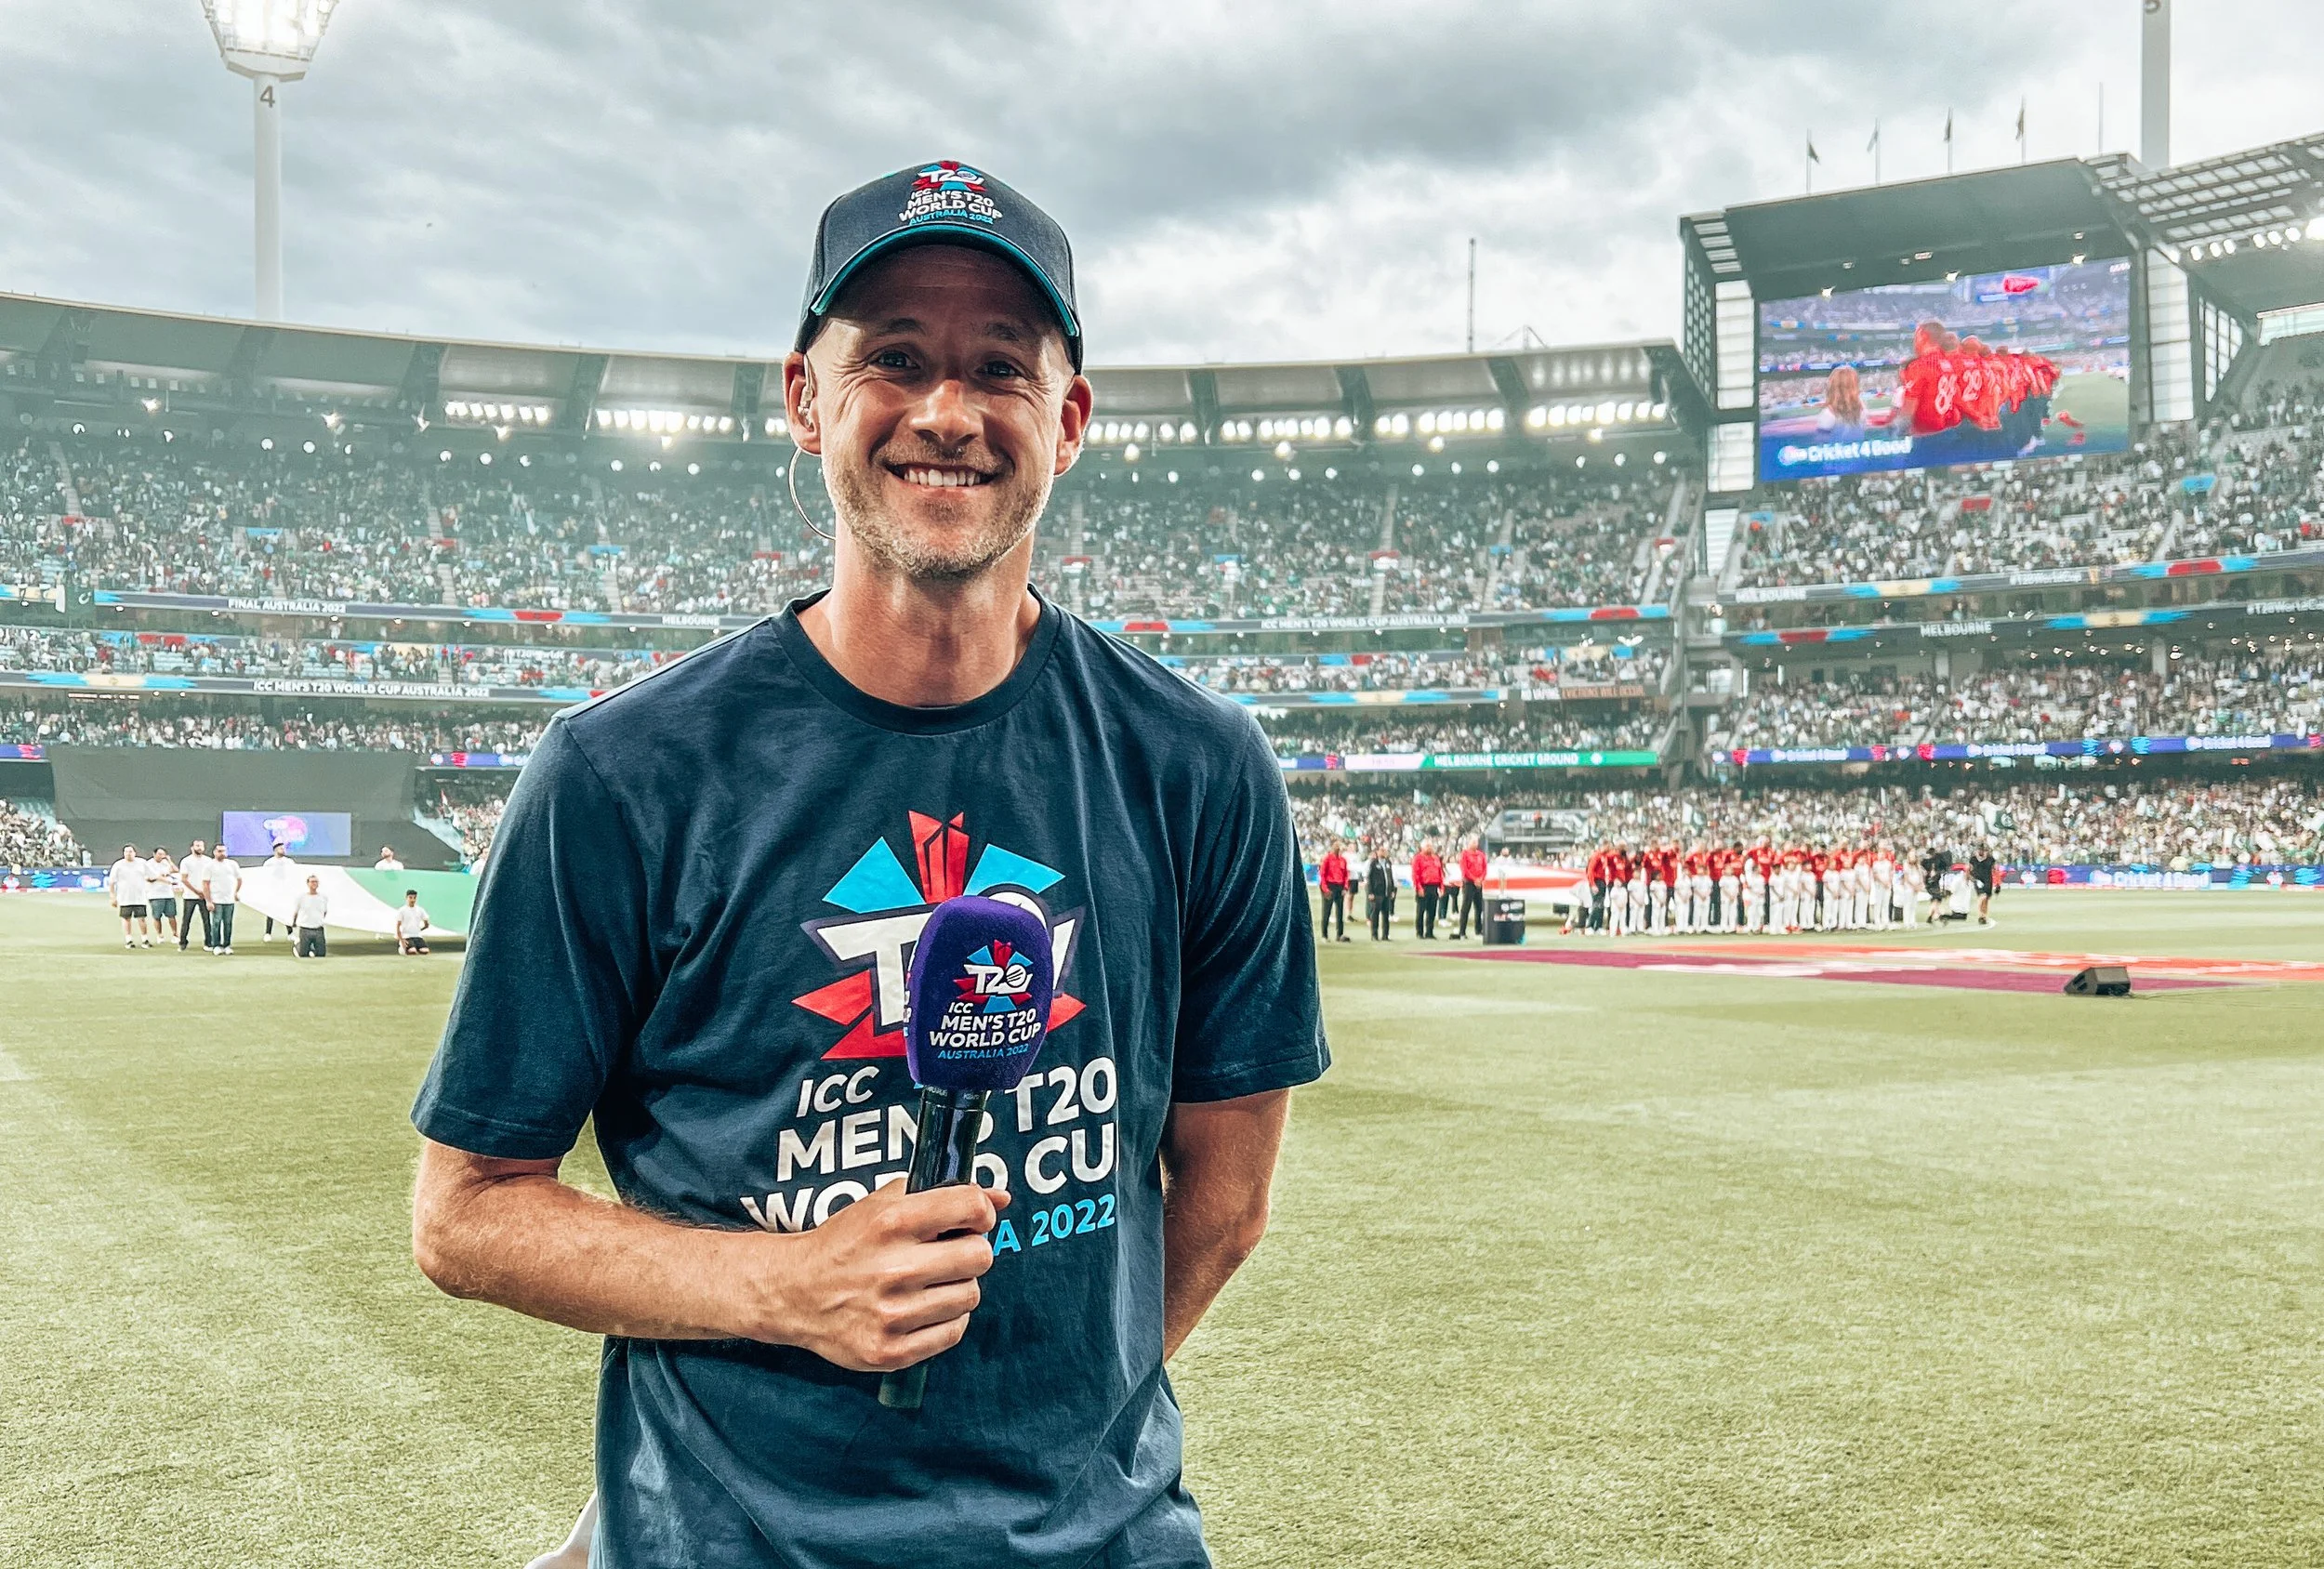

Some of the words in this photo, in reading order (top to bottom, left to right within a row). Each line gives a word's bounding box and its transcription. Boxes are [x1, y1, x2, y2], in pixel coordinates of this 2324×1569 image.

[259, 85, 276, 109] 4
[918, 169, 985, 185] T20
[907, 191, 963, 210] MEN'S
[963, 191, 995, 207] T20
[911, 188, 932, 200] ICC
[898, 200, 967, 222] WORLD
[968, 203, 1003, 219] CUP
[908, 209, 968, 226] AUSTRALIA
[969, 213, 994, 225] 2022
[1808, 442, 1859, 462] Cricket
[228, 599, 261, 610] FINAL
[262, 600, 321, 612] AUSTRALIA
[322, 603, 347, 613] 2022
[662, 614, 720, 626] MELBOURNE
[1328, 617, 1367, 627] WORLD
[1367, 616, 1389, 626] CUP
[1389, 615, 1445, 626] AUSTRALIA
[1921, 621, 1993, 638] MELBOURNE
[254, 680, 273, 692] ICC
[274, 681, 310, 692] MEN'S
[311, 682, 332, 692] T20
[332, 683, 376, 694] WORLD
[377, 684, 401, 695] CUP
[401, 685, 463, 697] AUSTRALIA
[465, 687, 490, 698] 2022
[1433, 753, 1493, 767] MELBOURNE
[1494, 753, 1535, 767] CRICKET
[1536, 753, 1578, 766] GROUND
[2114, 871, 2162, 887] Cricket
[963, 964, 1033, 995] T20
[948, 1002, 973, 1014] ICC
[941, 1014, 1004, 1031] MEN'S
[1007, 1009, 1037, 1027] T20
[929, 1031, 1005, 1048] WORLD
[1008, 1022, 1042, 1044] CUP
[938, 1049, 1004, 1060] AUSTRALIA
[1007, 1044, 1030, 1057] 2022
[796, 1066, 879, 1118] ICC
[776, 1090, 995, 1182] MEN
[1005, 1057, 1116, 1133] T20
[1024, 1121, 1119, 1194] CU
[1031, 1193, 1116, 1247] 2022
